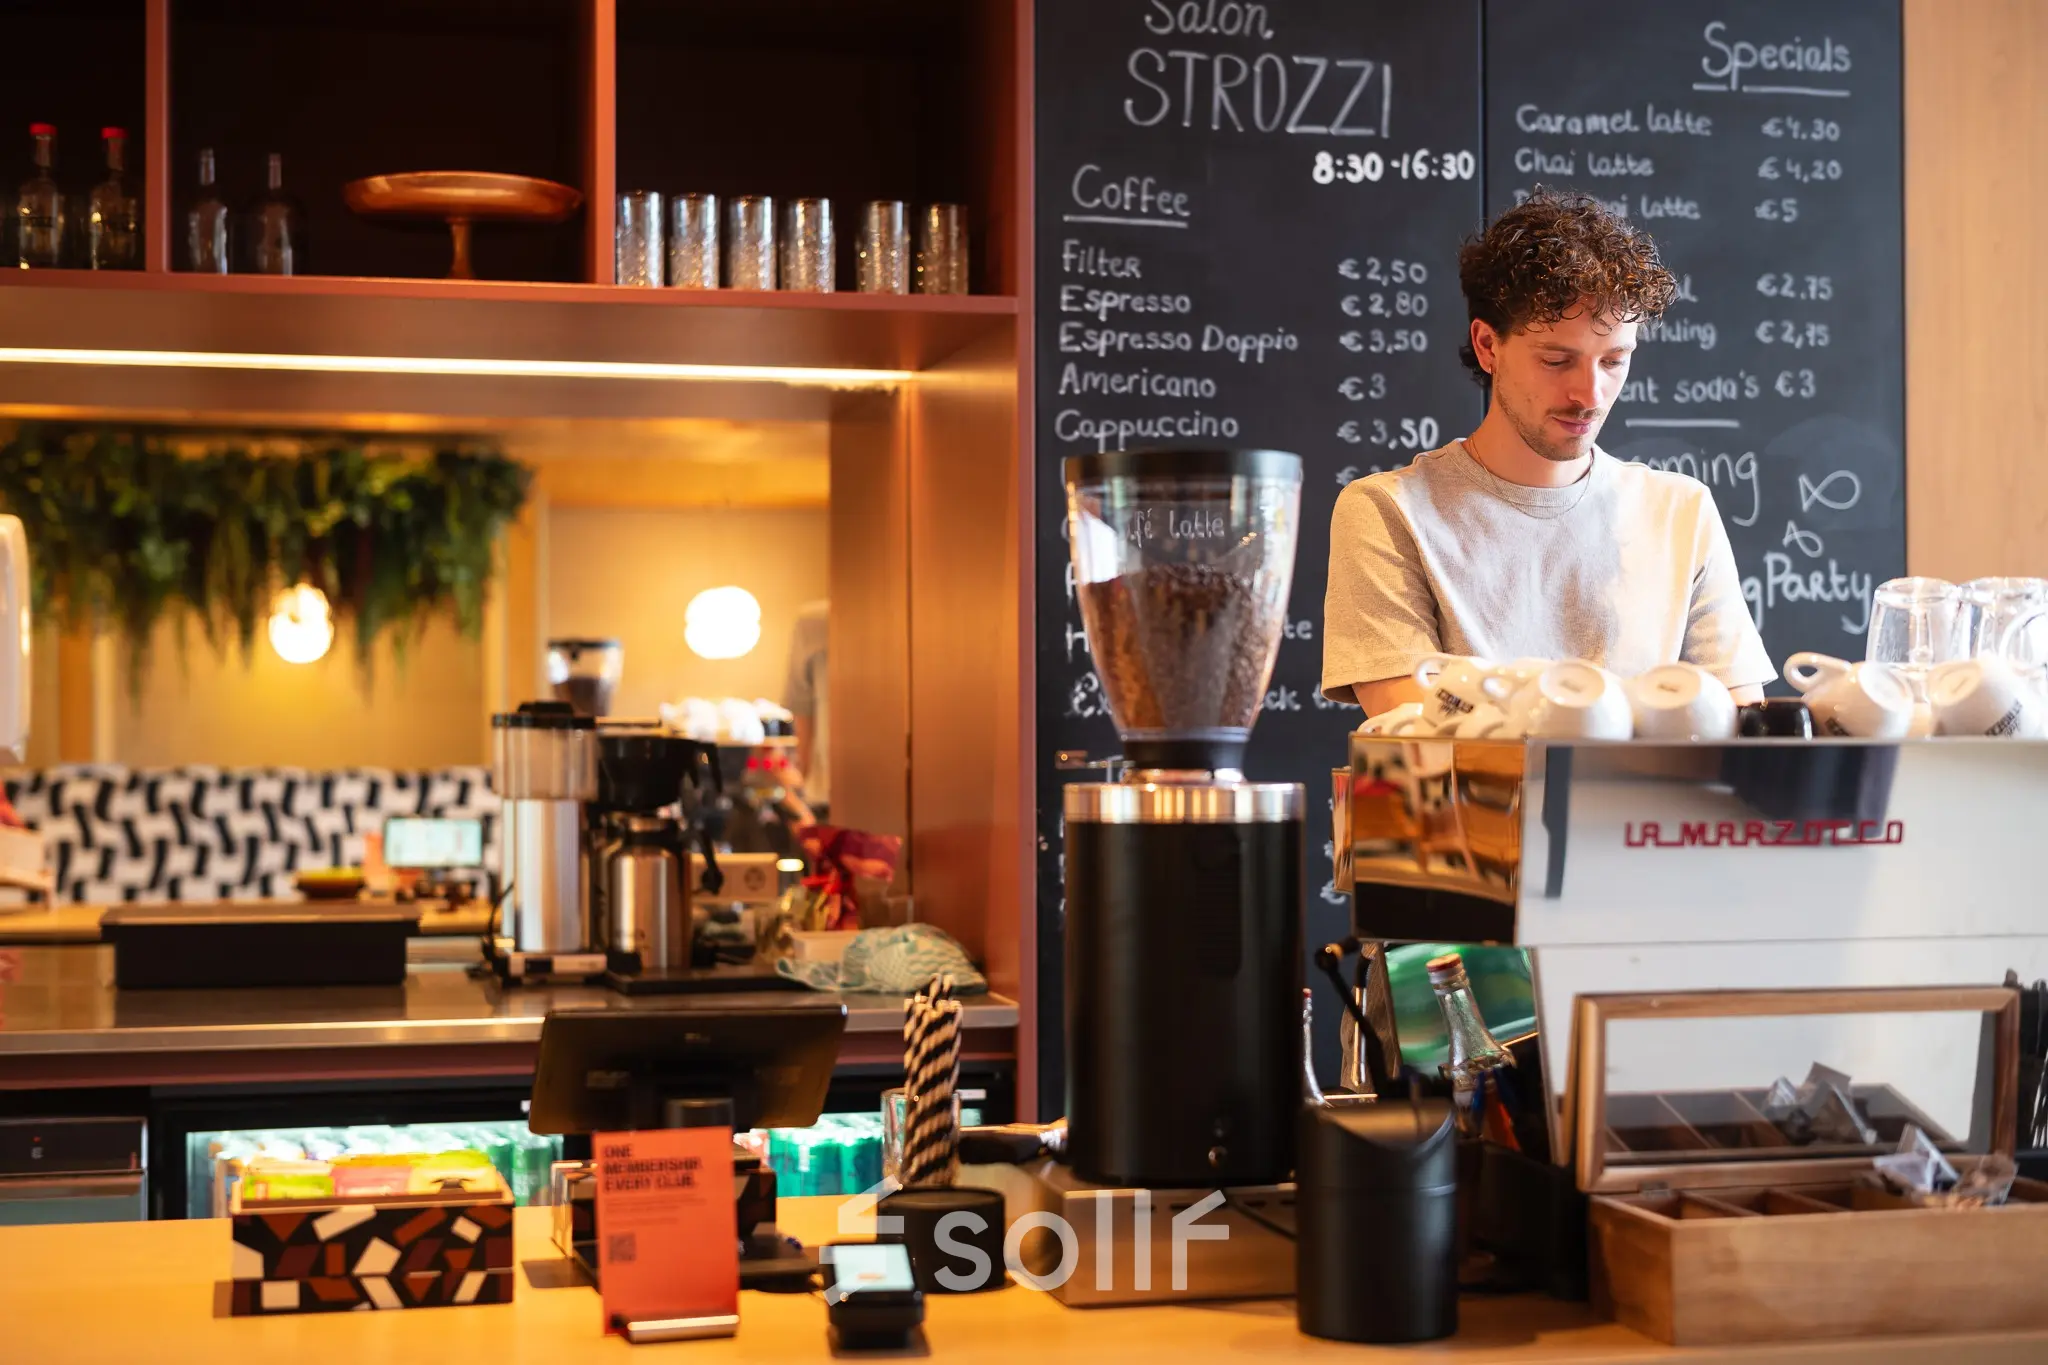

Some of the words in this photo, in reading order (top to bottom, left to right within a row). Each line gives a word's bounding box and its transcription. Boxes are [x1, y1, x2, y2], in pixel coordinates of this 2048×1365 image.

[1144, 0, 1274, 40] Salon
[1701, 21, 1852, 91] Specials
[1124, 48, 1392, 138] STROZZI
[1515, 103, 1641, 136] Caramel
[1646, 103, 1713, 137] latte
[1311, 150, 1384, 186] 8:30
[1514, 146, 1576, 177] Chai
[1587, 151, 1656, 178] latte
[1072, 163, 1191, 217] Coffee
[1640, 194, 1702, 221] latte
[1062, 238, 1143, 279] Filter
[1060, 285, 1192, 322] Espresso
[1059, 321, 1192, 357] Espresso
[1201, 324, 1299, 364] Doppio
[1058, 362, 1217, 399] Americano
[1673, 369, 1761, 405] soda's
[1055, 409, 1240, 454] Cappuccino
[1764, 551, 1873, 636] Party
